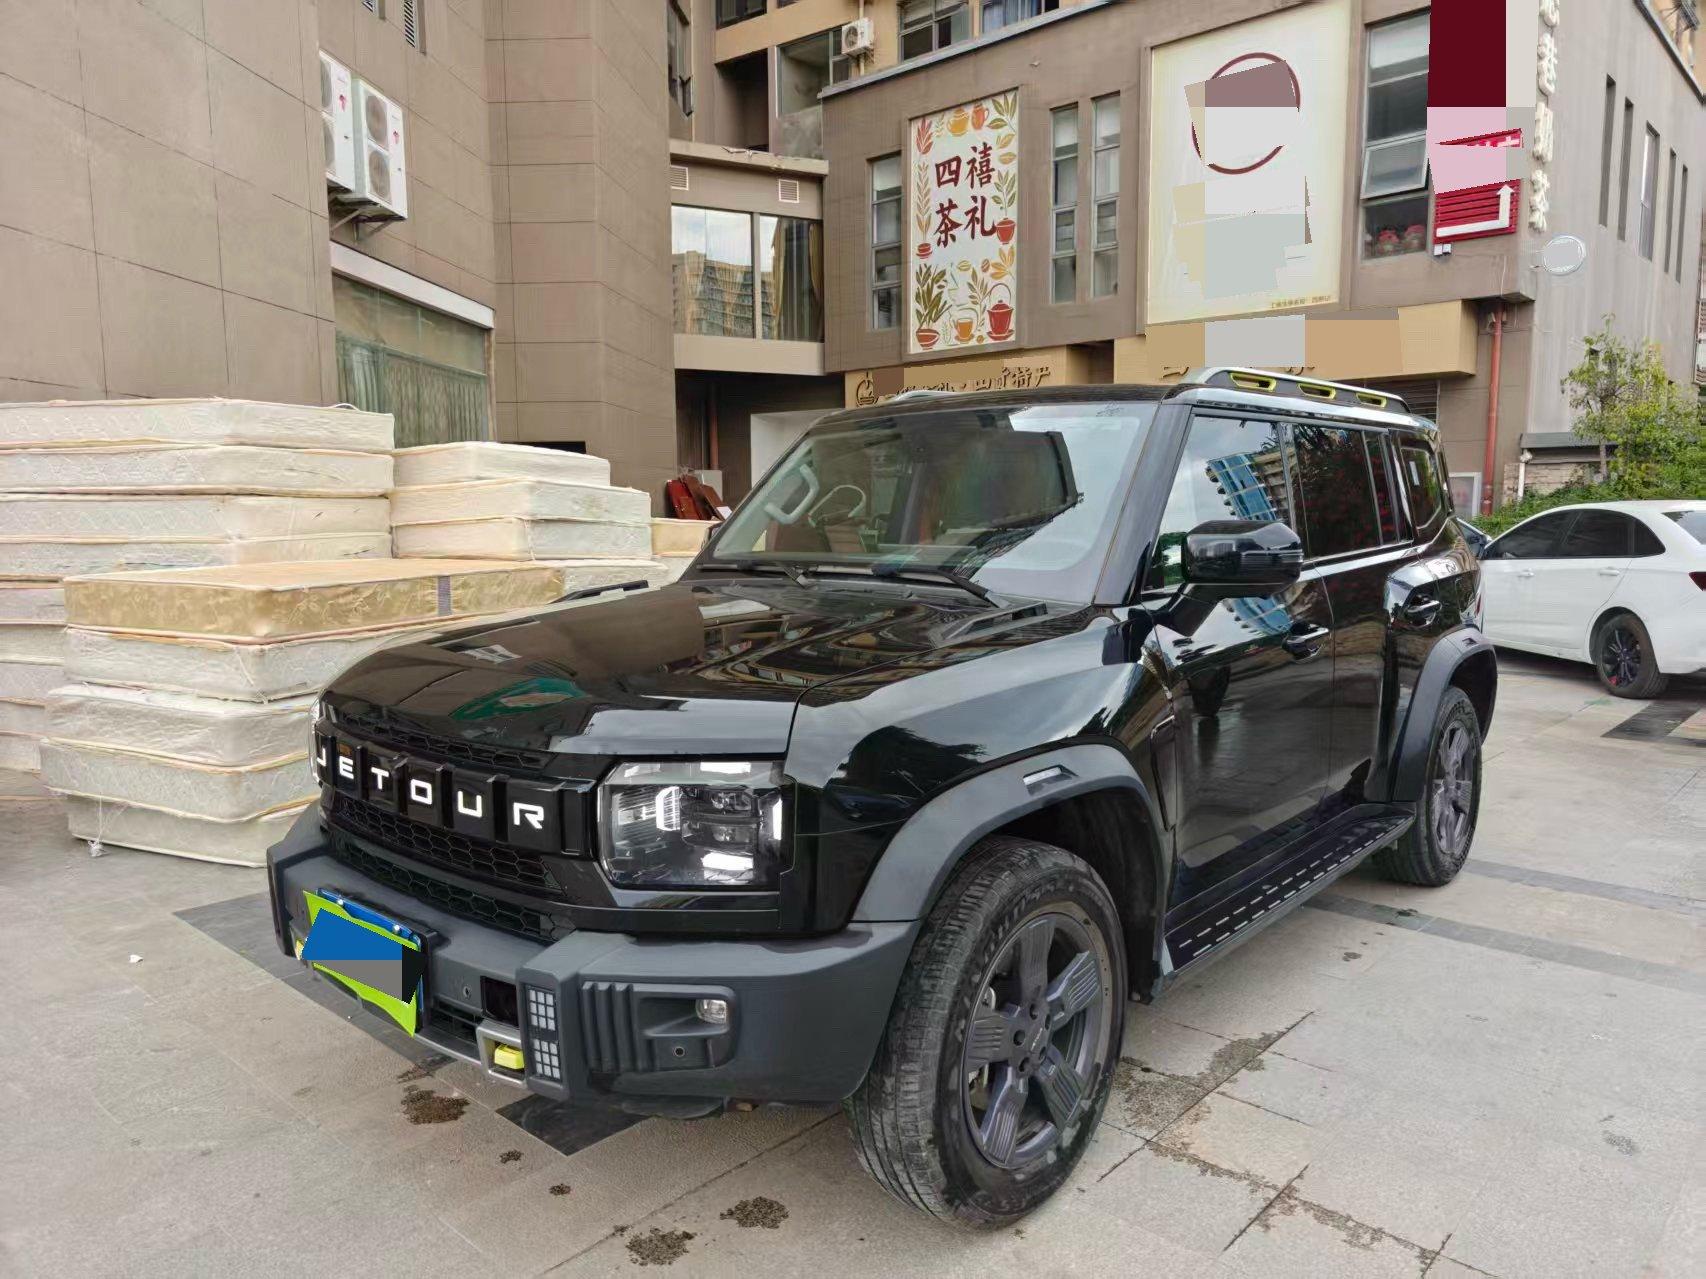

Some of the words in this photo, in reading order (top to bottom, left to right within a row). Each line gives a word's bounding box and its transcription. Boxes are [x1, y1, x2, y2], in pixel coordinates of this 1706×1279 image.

[935, 142, 996, 190] 四禧
[934, 196, 997, 249] 茶礼
[316, 748, 545, 829] JETOUR
